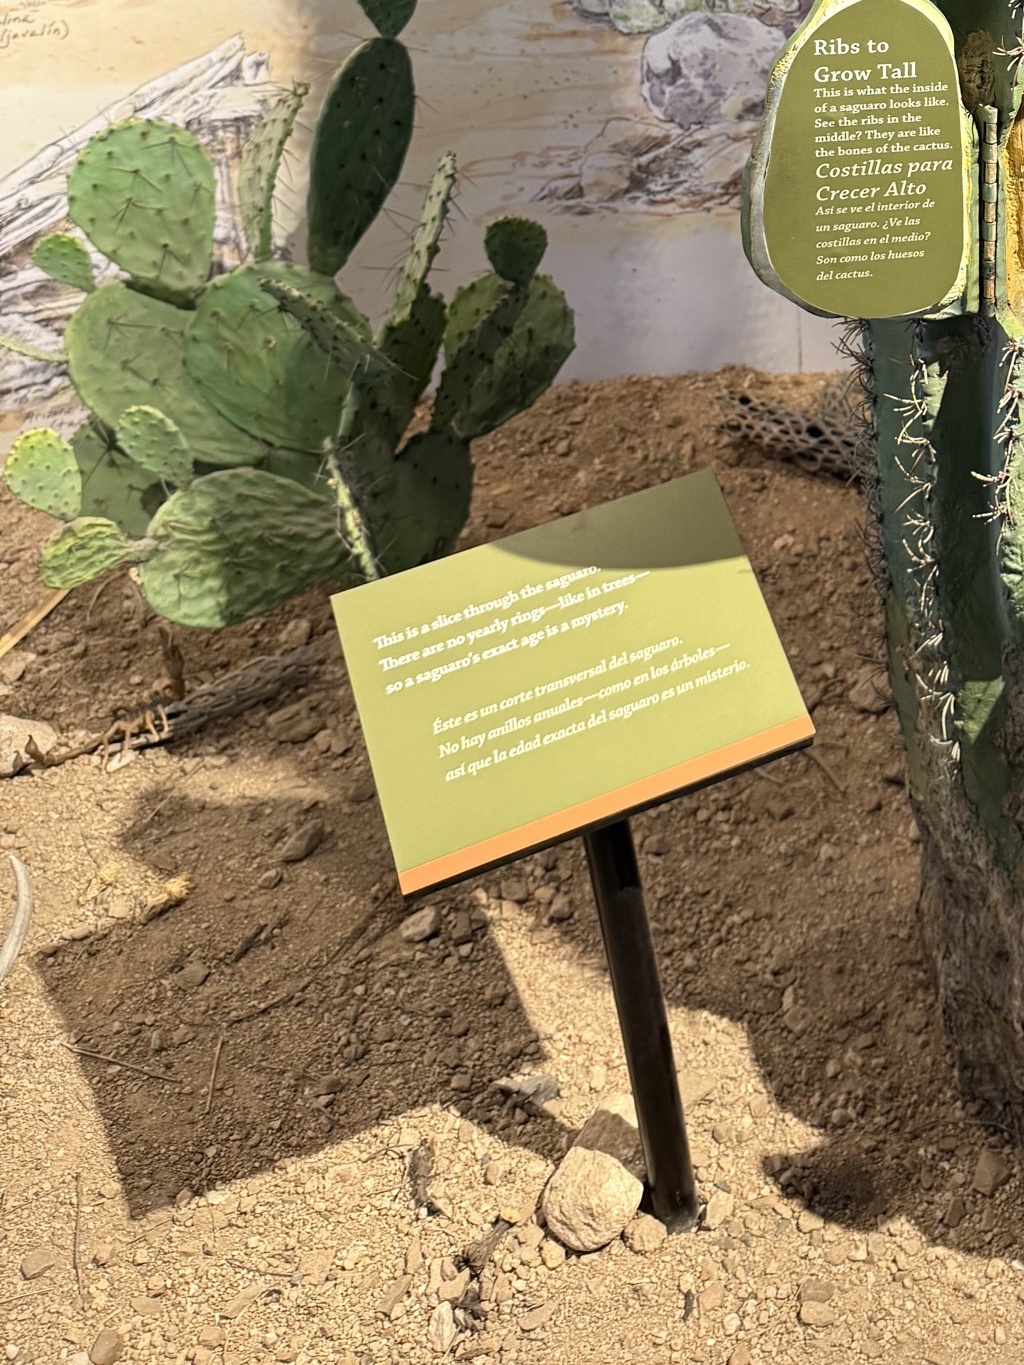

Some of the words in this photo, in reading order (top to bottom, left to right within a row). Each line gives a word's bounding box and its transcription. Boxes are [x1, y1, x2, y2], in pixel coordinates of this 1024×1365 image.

[814, 38, 860, 55] Ribs
[867, 40, 889, 53] to
[814, 66, 872, 82] Grow
[877, 61, 917, 79] Tall
[813, 88, 841, 98] This
[844, 87, 854, 96] is
[856, 85, 887, 96] what
[890, 84, 910, 94] the
[912, 82, 948, 93] inside
[814, 103, 828, 113] of
[839, 103, 887, 114] saguaro
[889, 98, 921, 109] looks
[924, 96, 949, 107] like.
[814, 118, 835, 128] See
[838, 116, 858, 126] the
[861, 115, 884, 125] ribs
[887, 114, 899, 124] in
[902, 113, 922, 123] the
[816, 159, 903, 178] Costillas
[907, 160, 953, 178] para
[816, 186, 880, 201] Crecer
[883, 180, 926, 197] Alto
[815, 206, 834, 215] Así
[865, 202, 875, 212] el
[877, 200, 921, 211] interior
[922, 198, 935, 208] de
[833, 222, 879, 232] saguaro.
[882, 218, 902, 230] ¿Ve
[905, 216, 920, 225] las
[816, 256, 837, 264] Son
[840, 255, 868, 263] como
[870, 251, 886, 261] los
[888, 250, 925, 259] huesos
[816, 271, 833, 281] del
[835, 271, 873, 279] cactus.
[372, 632, 405, 650] This
[405, 626, 419, 639] is
[420, 624, 431, 635] a
[430, 612, 463, 631] slice
[463, 590, 520, 620] through
[519, 584, 544, 599] the
[545, 566, 601, 591] saguaro.
[378, 651, 421, 672] There
[421, 642, 445, 658] are
[446, 635, 466, 649] no
[466, 618, 509, 645] yearly
[585, 587, 602, 599] in
[385, 681, 403, 695] so
[404, 677, 415, 688] a
[481, 638, 520, 660] exact
[521, 630, 545, 648] age
[545, 625, 559, 638] is
[559, 621, 570, 633] a
[569, 601, 629, 629] mystery.
[432, 716, 462, 735] Éste
[463, 710, 479, 723] es
[479, 703, 498, 717] un
[499, 690, 533, 711] corte
[534, 659, 608, 698] transversal
[608, 651, 629, 670] del
[629, 637, 683, 663] saguaro.
[439, 742, 459, 759] No
[460, 732, 486, 750] hay
[487, 716, 532, 740] anillos
[633, 672, 650, 686] en
[649, 665, 669, 680] los
